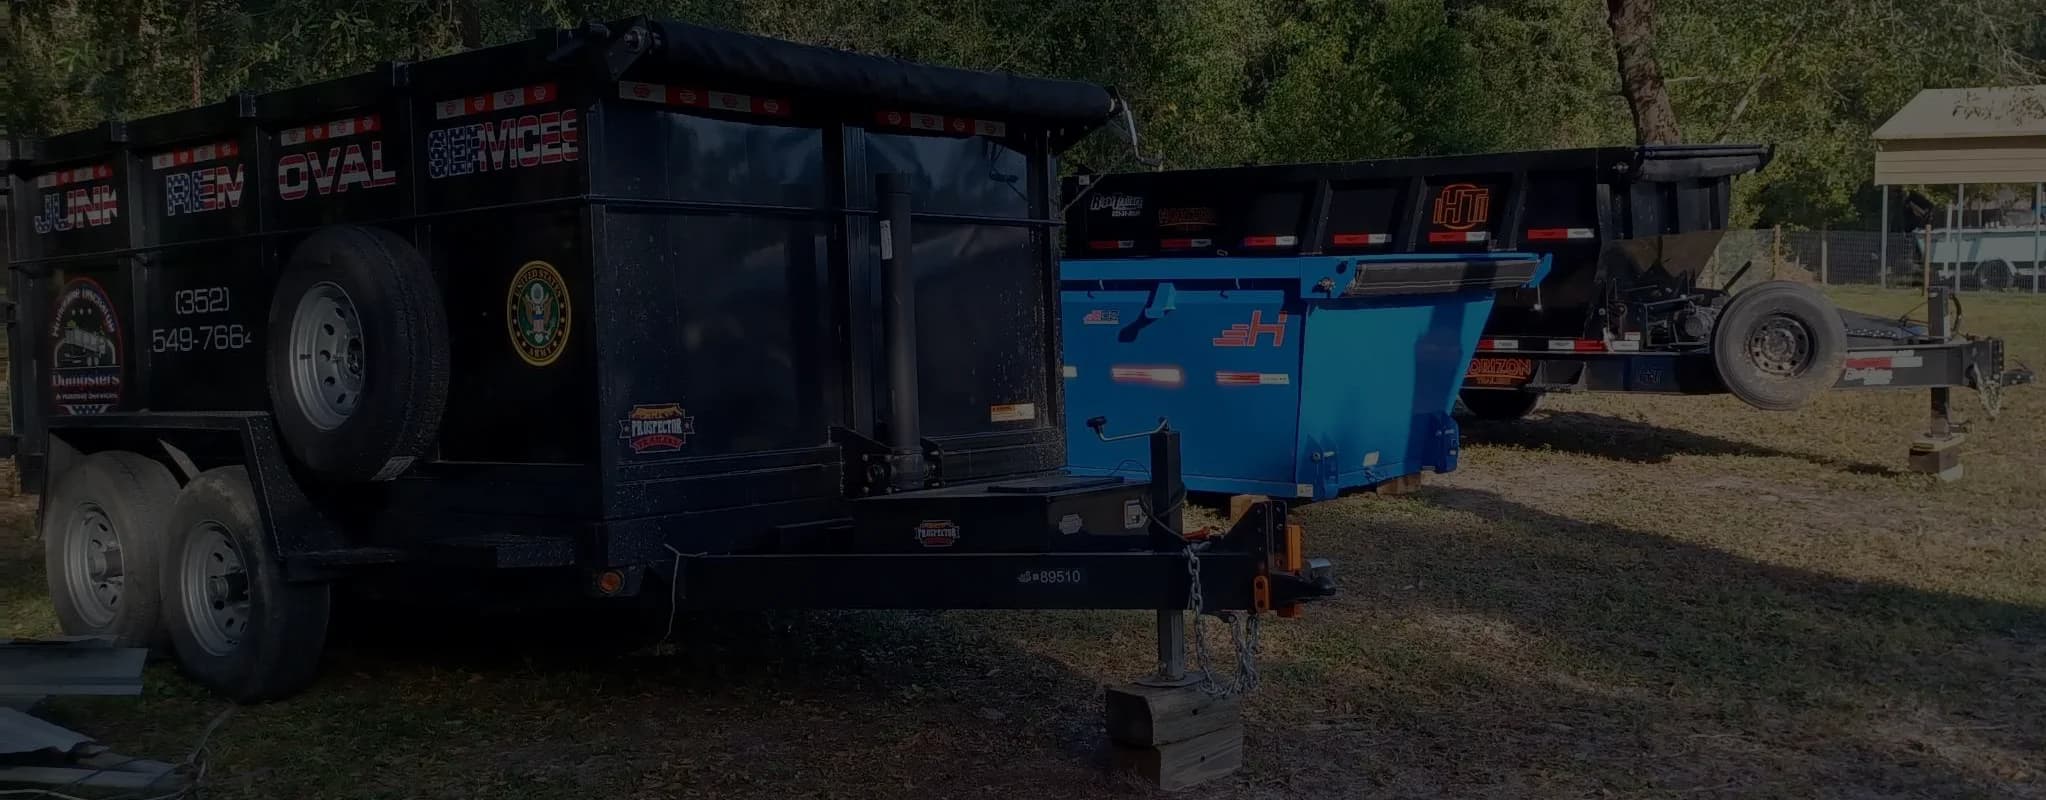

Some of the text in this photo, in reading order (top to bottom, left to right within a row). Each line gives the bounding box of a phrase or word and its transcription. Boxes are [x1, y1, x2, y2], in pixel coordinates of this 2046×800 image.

[277, 140, 398, 201] OVAL
[428, 108, 579, 180] SERVICES
[175, 286, 230, 315] (352)
[631, 418, 683, 437] PROSPECTOR
[1040, 569, 1081, 584] 89510
